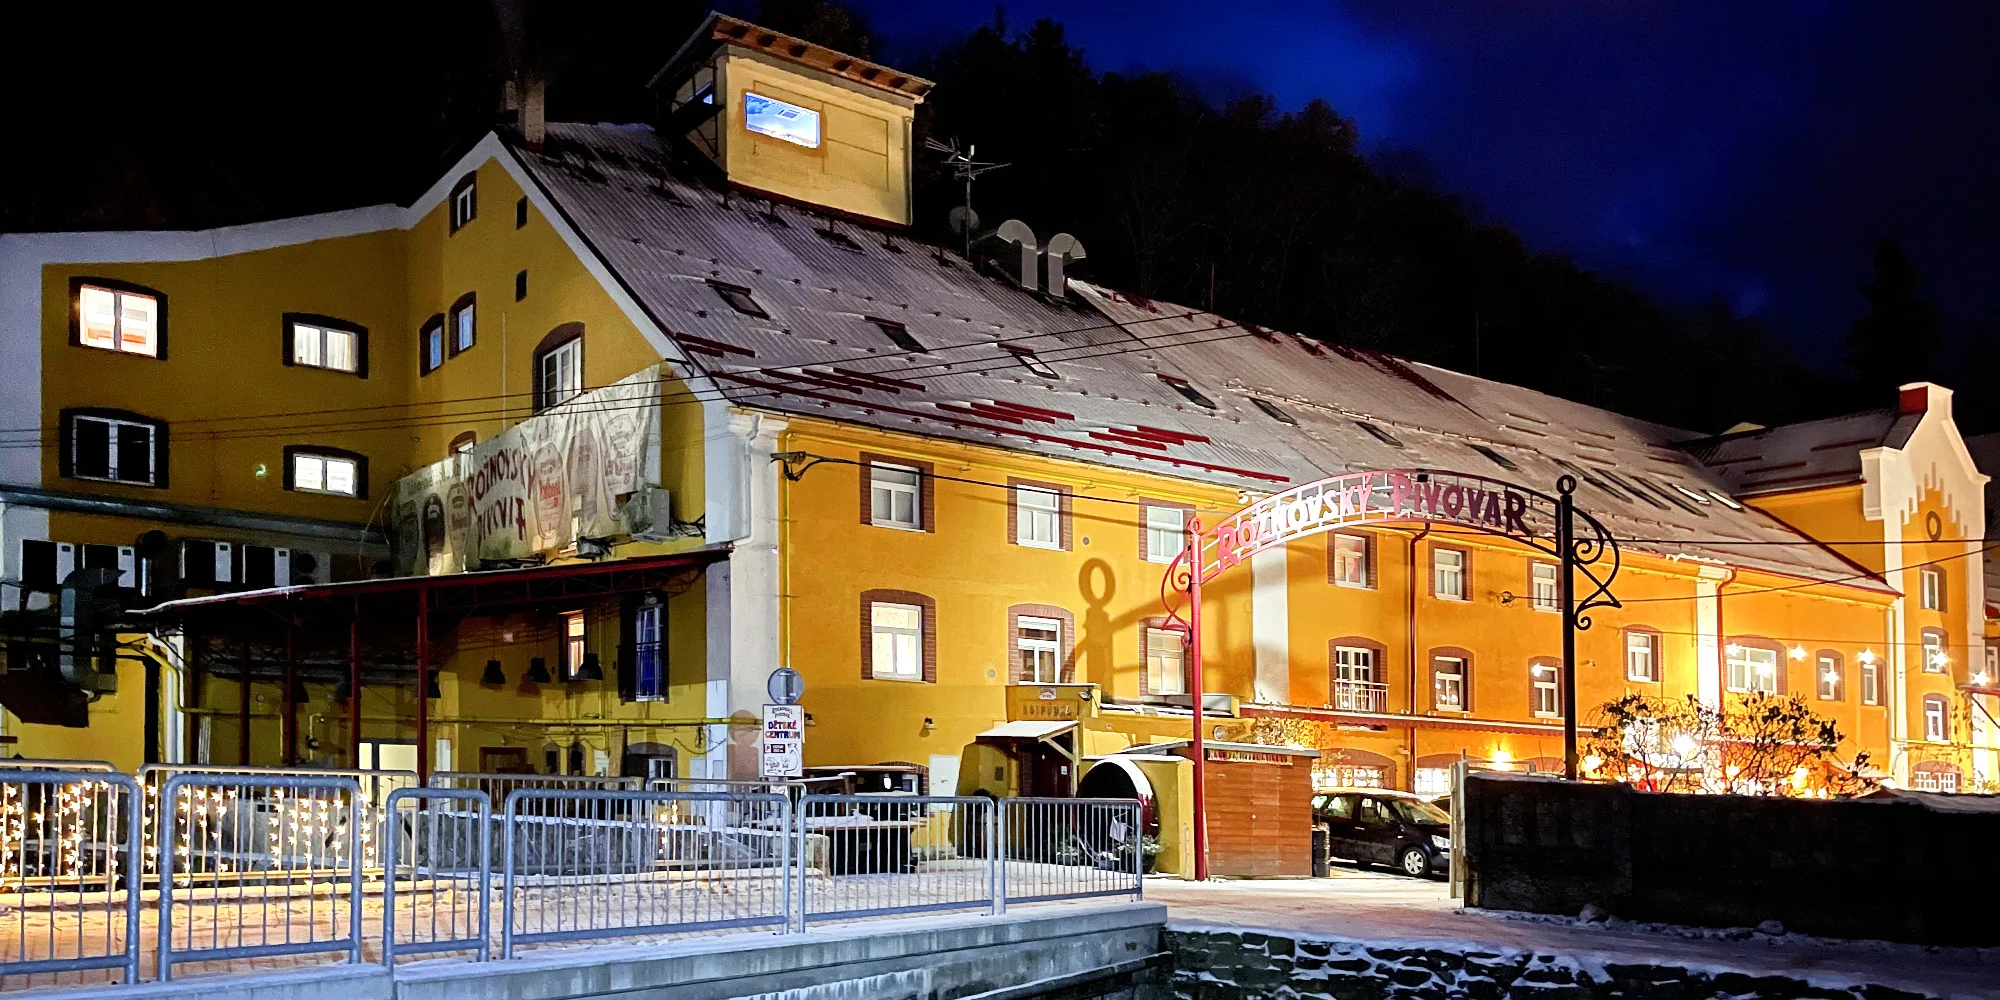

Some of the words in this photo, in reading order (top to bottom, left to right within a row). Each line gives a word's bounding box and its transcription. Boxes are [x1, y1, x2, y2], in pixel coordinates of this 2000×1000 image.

[1216, 473, 1373, 573] ROŽNOVSKÝ
[768, 720, 796, 730] DĚTSKÉ
[765, 730, 800, 739] CENTRUM
